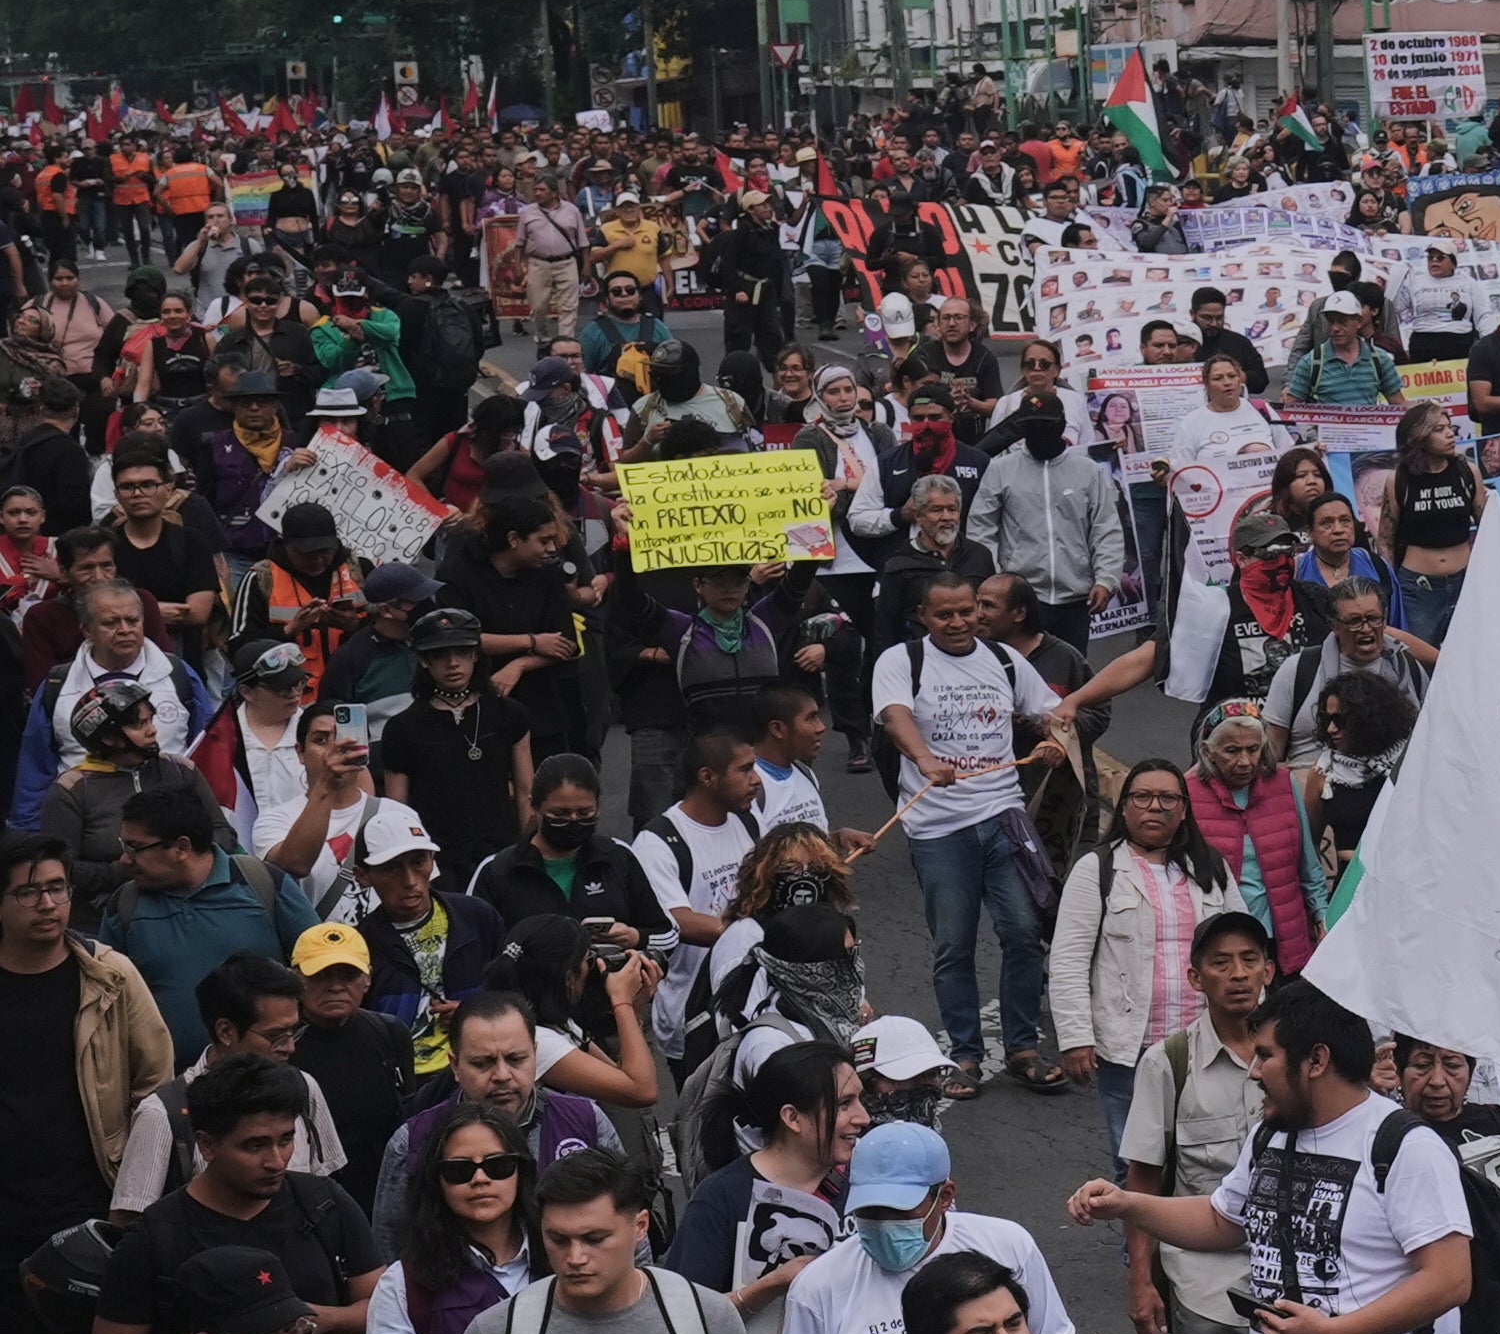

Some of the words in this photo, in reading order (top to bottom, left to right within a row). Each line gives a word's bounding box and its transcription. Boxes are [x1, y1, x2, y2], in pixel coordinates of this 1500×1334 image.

[1370, 39, 1377, 50] 2
[1380, 39, 1395, 49] de
[1398, 37, 1445, 49] octubre
[1448, 35, 1477, 47] 1968
[1371, 54, 1387, 65] 10
[1391, 54, 1407, 64] de
[1411, 52, 1446, 65] junio
[1450, 50, 1479, 62] 1971
[1388, 68, 1399, 79] de
[955, 467, 978, 479] 1954
[629, 490, 646, 506] la
[1420, 488, 1433, 500] MY
[1414, 499, 1433, 512] NOT
[1434, 497, 1465, 510] YOURS
[389, 498, 430, 533] 1968
[657, 503, 746, 528] PRETEXTO
[757, 510, 786, 526] para
[793, 497, 823, 517] NO
